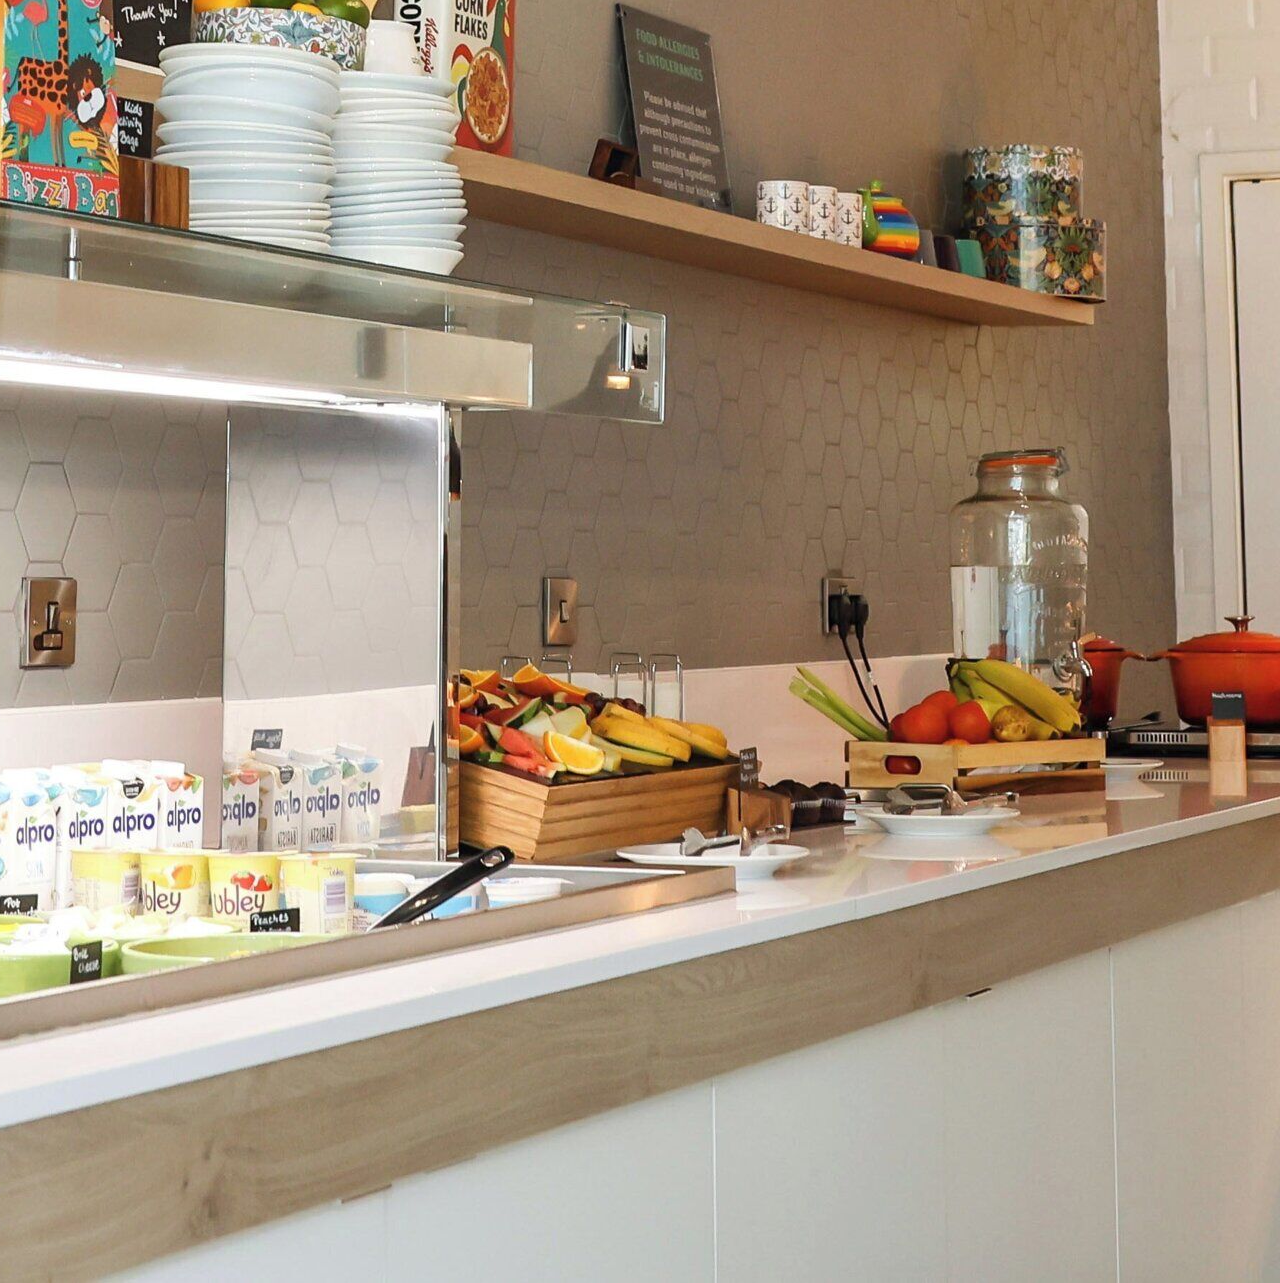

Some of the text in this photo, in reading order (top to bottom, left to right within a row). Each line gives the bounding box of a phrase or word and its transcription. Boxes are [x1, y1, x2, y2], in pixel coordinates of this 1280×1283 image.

[121, 5, 156, 24] Thank
[454, 13, 488, 41] FLAKES
[421, 18, 438, 74] Kellogg's
[636, 28, 700, 60] FOOD ALLERGIES
[646, 52, 704, 82] INTOLERANCES
[124, 101, 143, 117] Kids
[118, 116, 143, 136] ctivity
[4, 163, 69, 210] Bizzi
[69, 812, 104, 845] alpro
[113, 807, 155, 839] alpro
[167, 800, 201, 833] alpro
[16, 817, 54, 851] alpro
[144, 880, 181, 914] bley
[252, 913, 289, 926] Peaches
